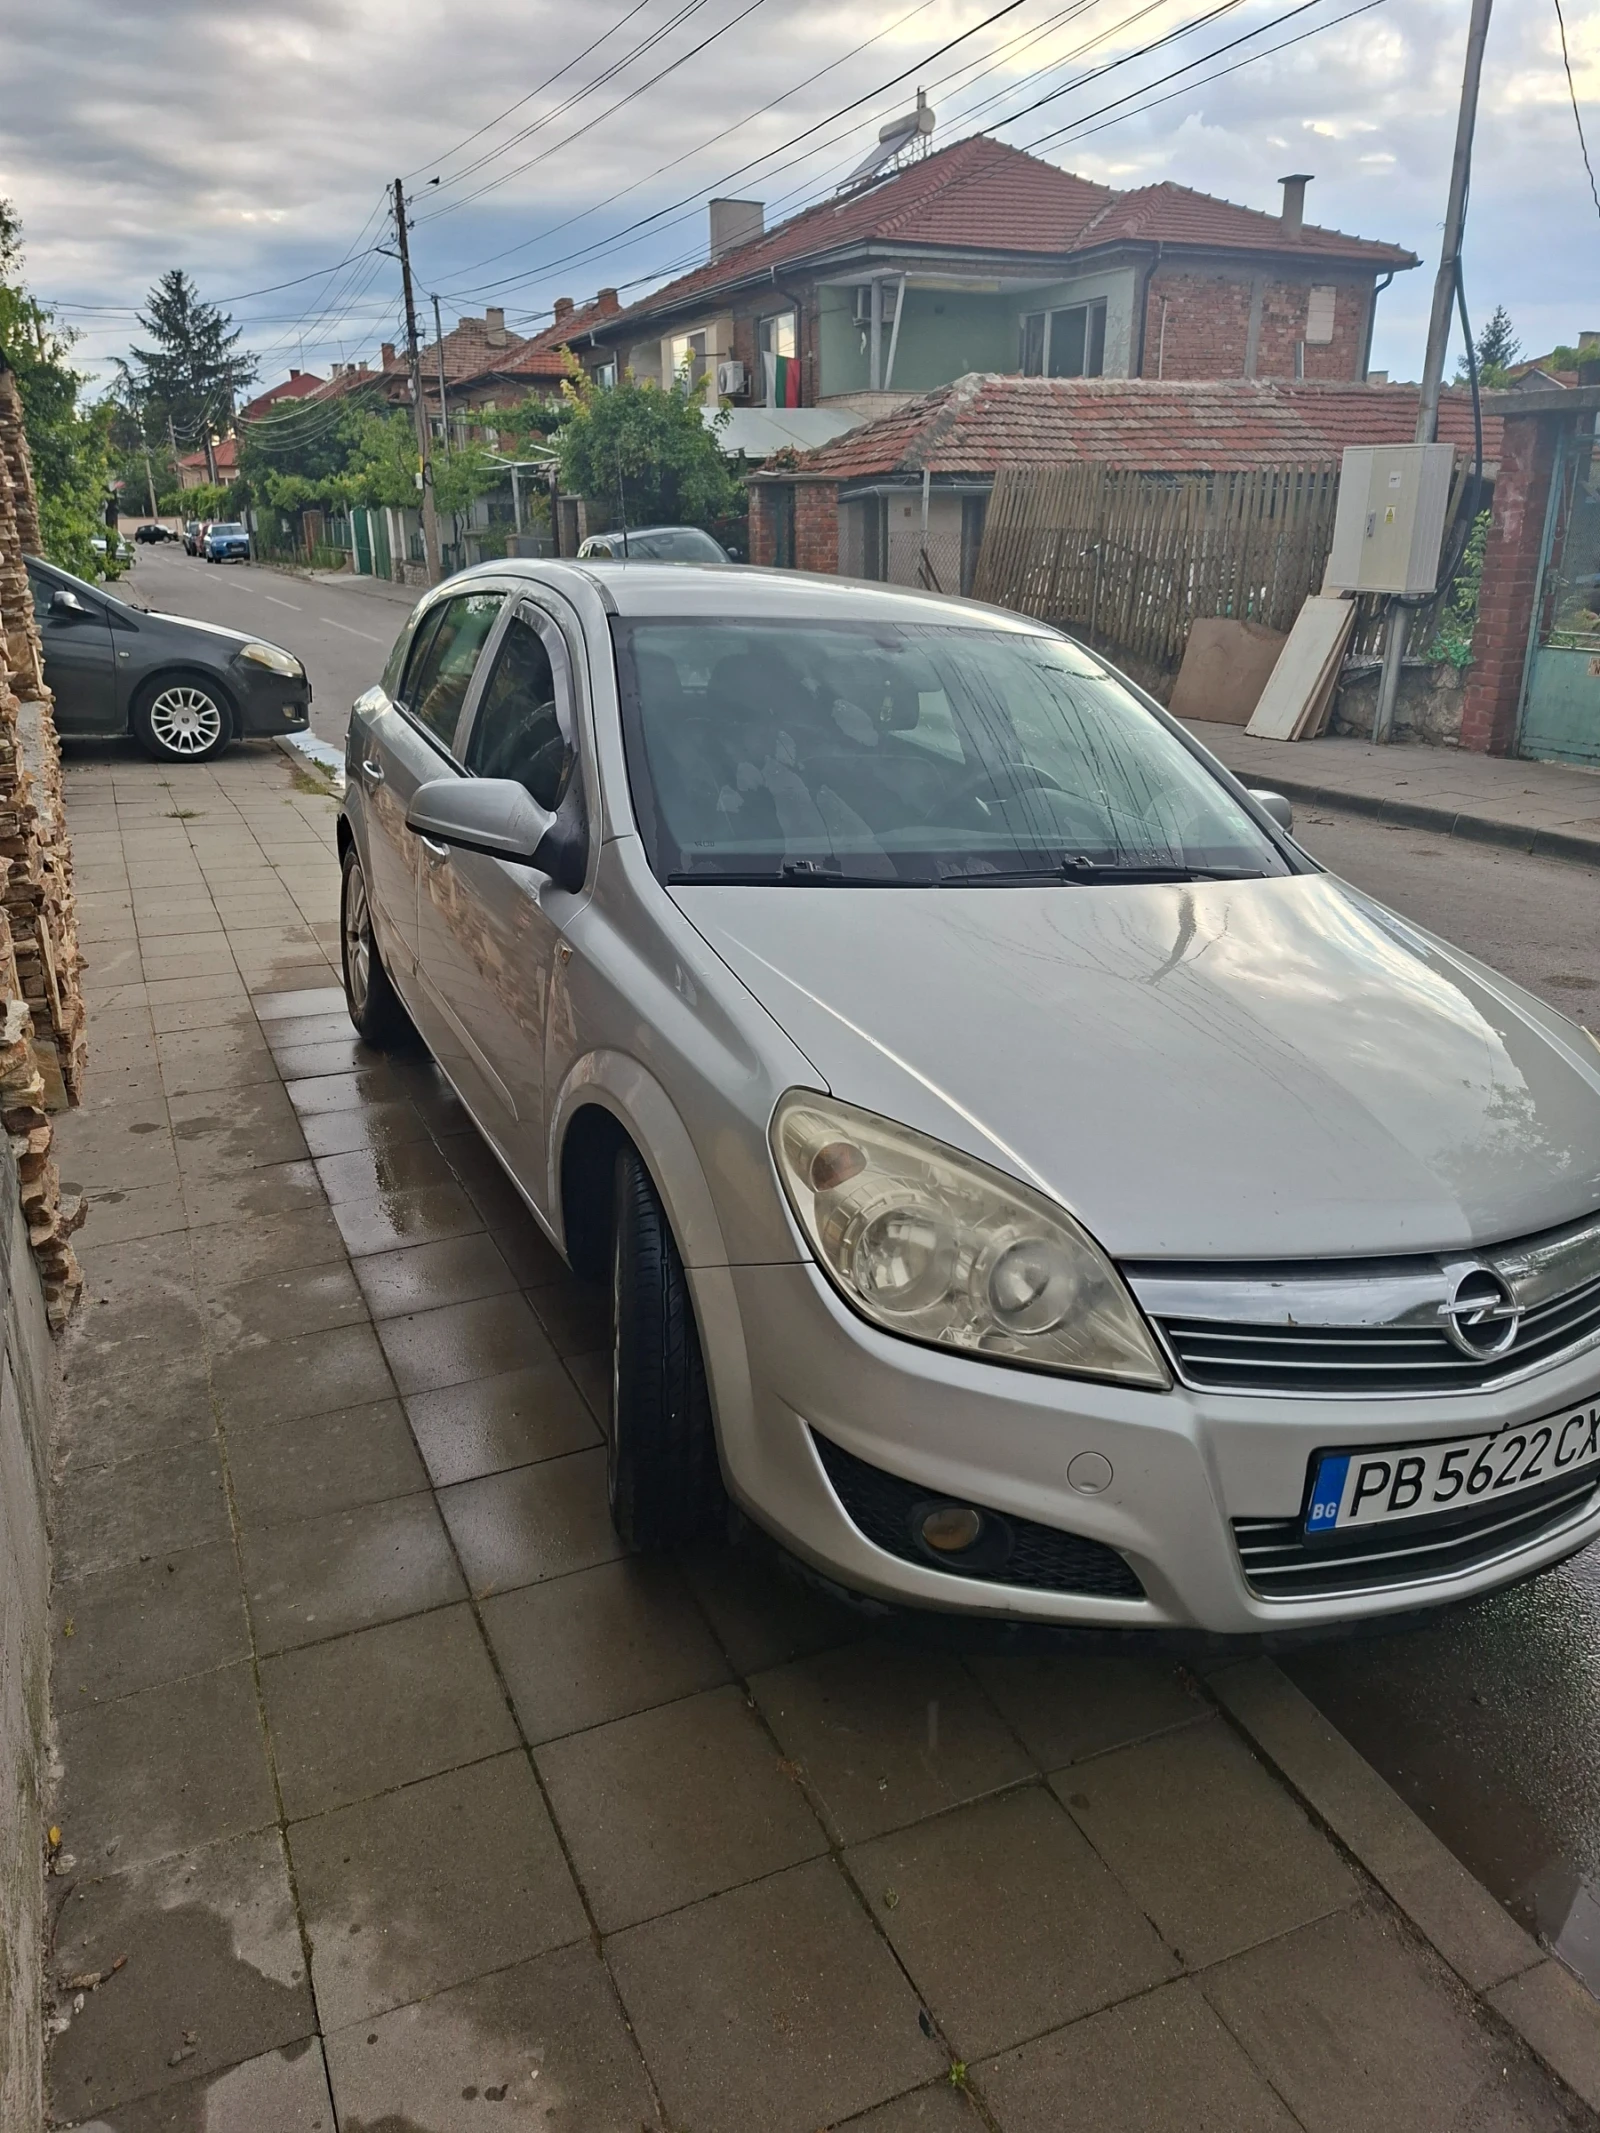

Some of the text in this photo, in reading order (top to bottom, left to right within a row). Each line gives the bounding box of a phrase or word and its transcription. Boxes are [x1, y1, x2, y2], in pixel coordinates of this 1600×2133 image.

[1348, 1456, 1426, 1518] PB
[1432, 1426, 1553, 1503] 5622
[1312, 1502, 1336, 1520] BG
